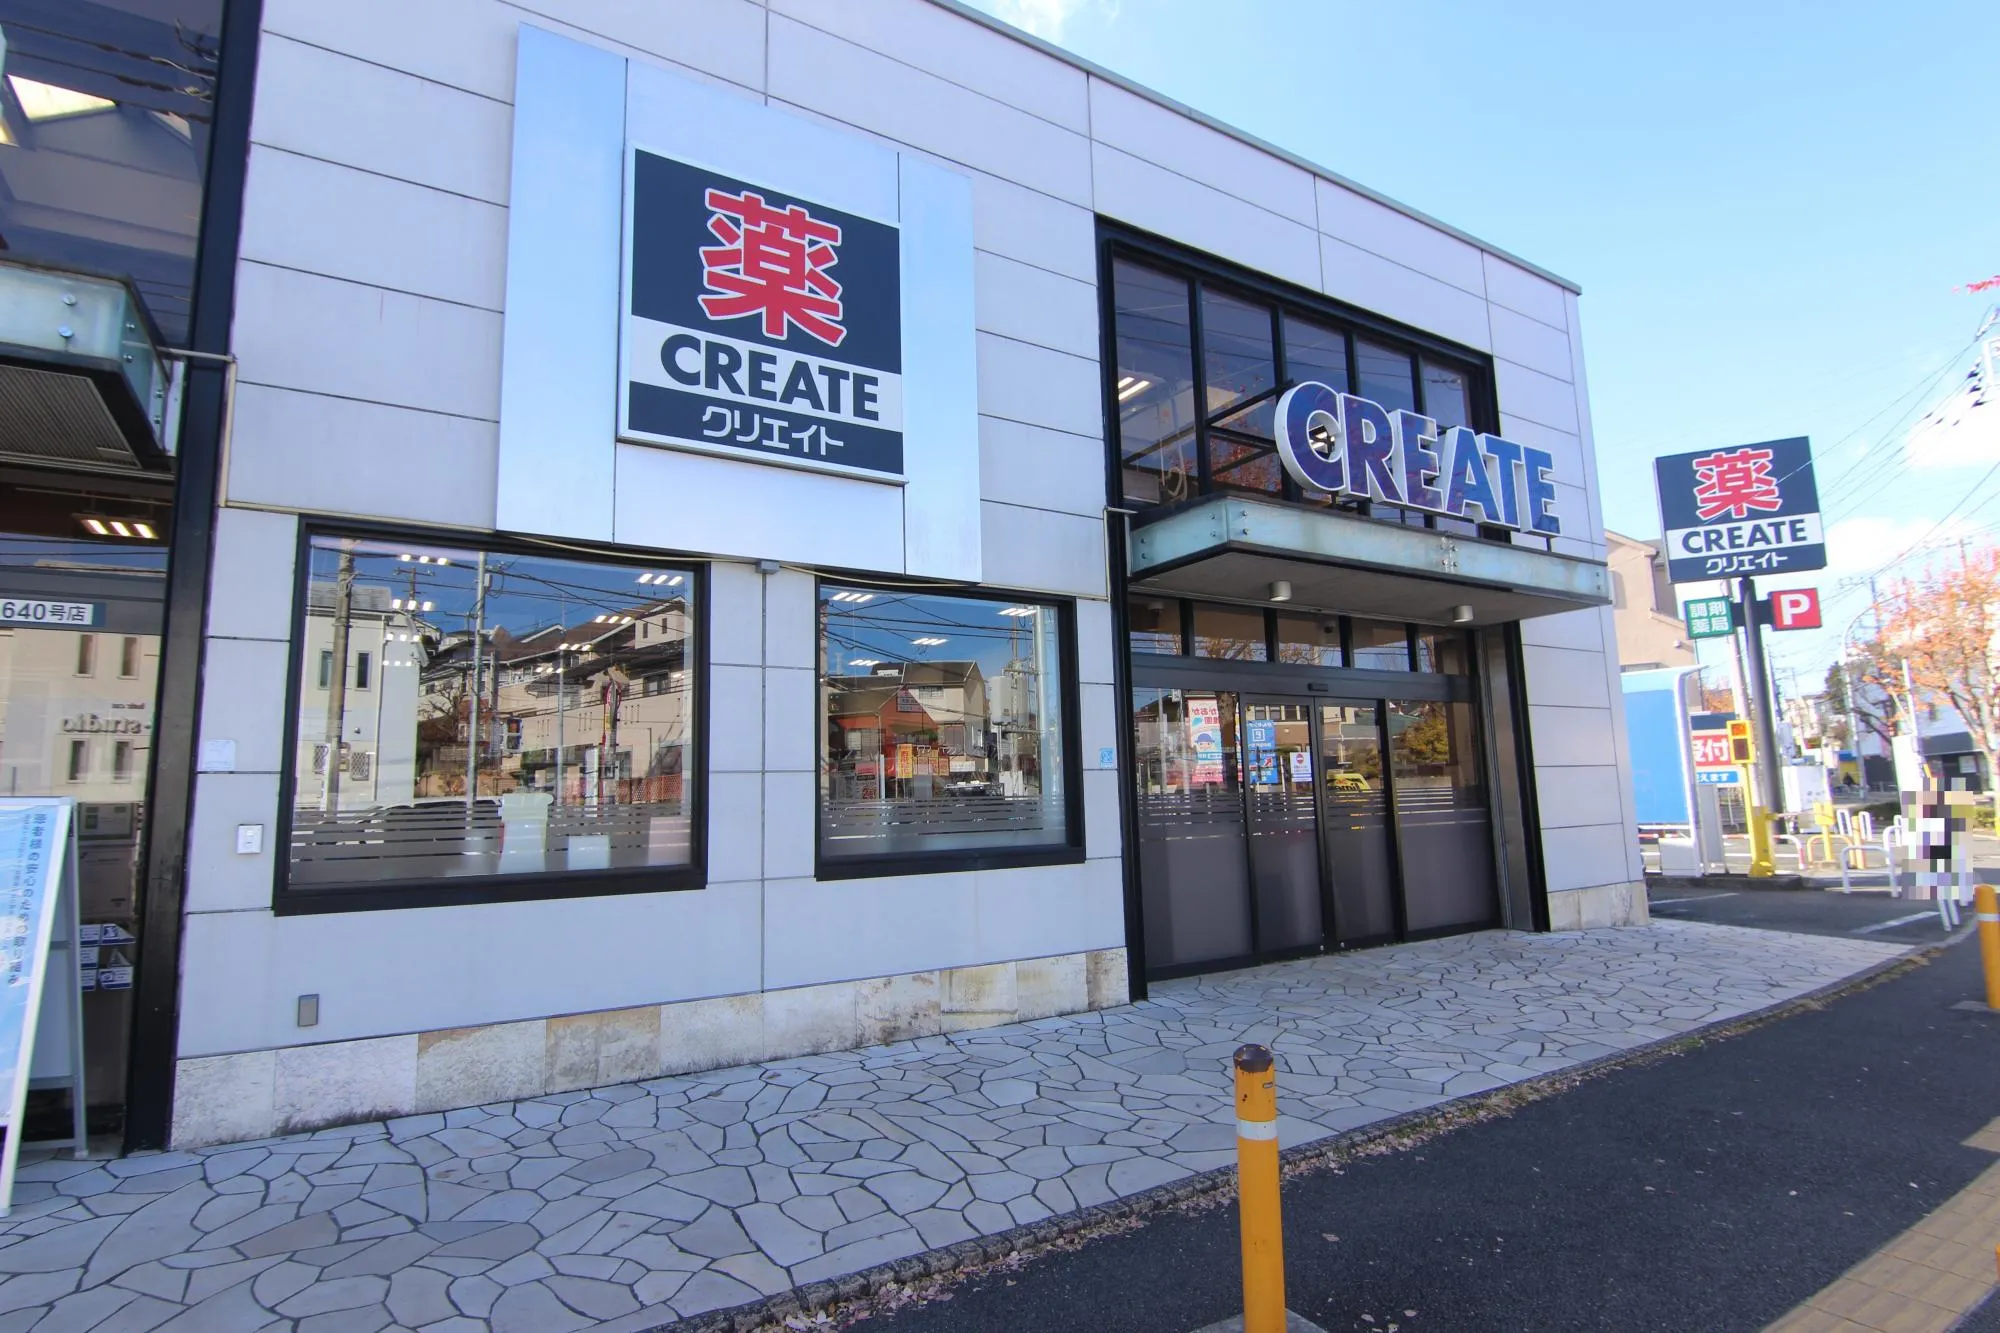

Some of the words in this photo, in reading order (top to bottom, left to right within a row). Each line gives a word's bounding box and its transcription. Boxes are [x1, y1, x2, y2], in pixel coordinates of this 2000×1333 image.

[697, 188, 847, 347] 薬
[661, 333, 879, 421] CREATE
[702, 405, 844, 455] クリエイト
[1274, 381, 1561, 538] CREATE
[1692, 448, 1783, 519] 薬
[1682, 518, 1807, 553] CREATE
[1706, 552, 1788, 574] クリエイト
[2, 602, 87, 622] 640号店
[1689, 601, 1726, 617] 調剤
[1691, 617, 1729, 634] 薬局
[1780, 593, 1811, 626] P
[1696, 772, 1730, 783] えます
